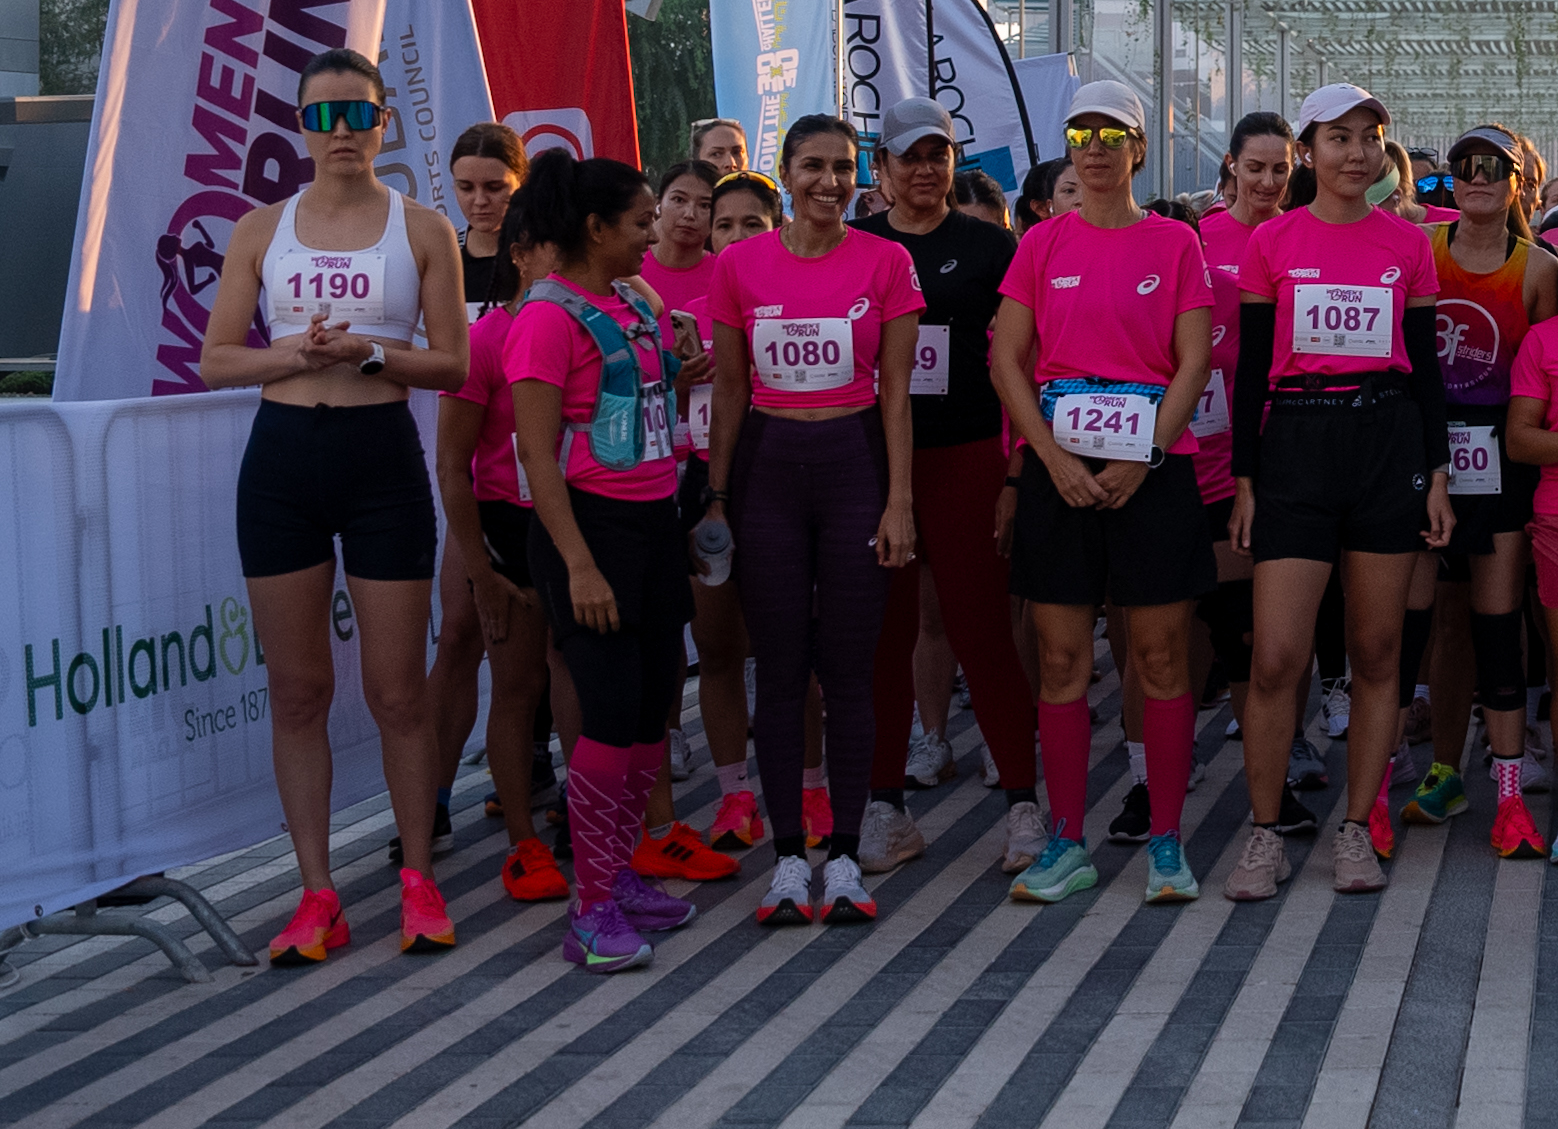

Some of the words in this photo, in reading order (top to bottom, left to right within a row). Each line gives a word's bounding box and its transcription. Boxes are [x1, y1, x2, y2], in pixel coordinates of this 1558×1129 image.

[399, 23, 437, 142] COUNCIL
[286, 272, 370, 299] 1190
[1306, 304, 1380, 331] 1087
[764, 339, 840, 366] 1080
[1066, 406, 1140, 435] 1241
[1452, 447, 1488, 471] 60
[25, 604, 217, 727] Holland
[183, 705, 237, 743] Since
[240, 688, 269, 724] 187
